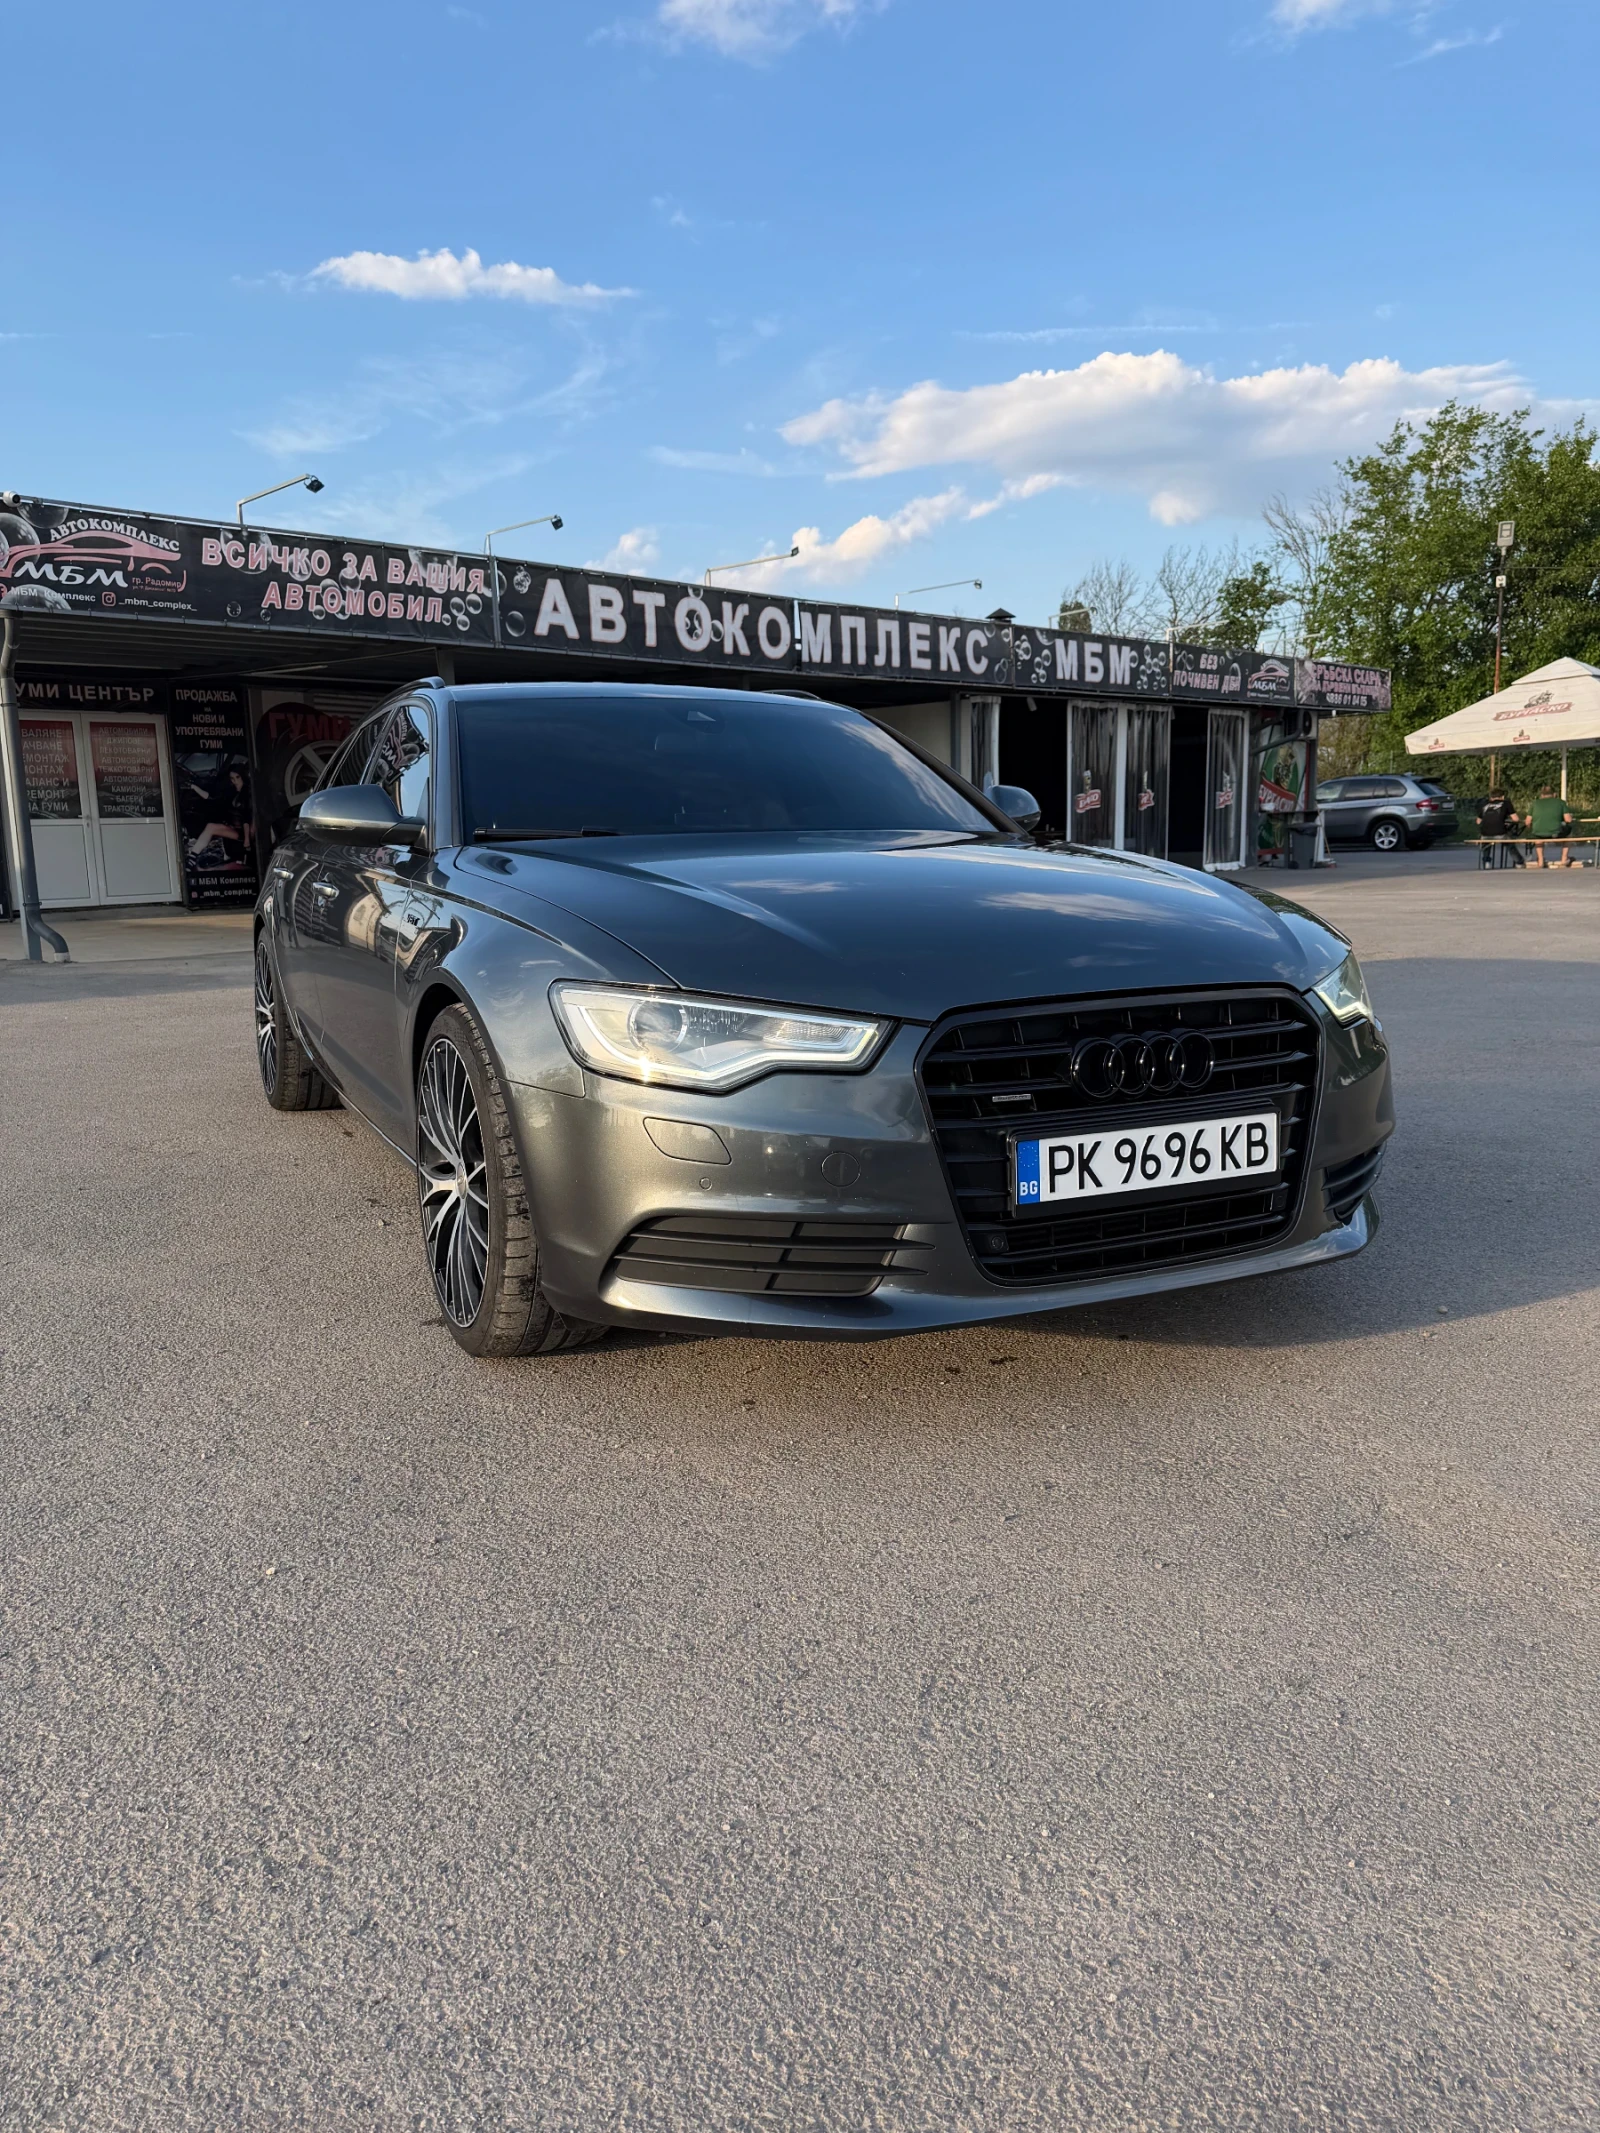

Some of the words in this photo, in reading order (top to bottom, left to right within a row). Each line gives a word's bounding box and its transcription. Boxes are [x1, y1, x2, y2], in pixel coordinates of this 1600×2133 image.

[50, 518, 180, 551] АВТОКОМПЛЕКС
[201, 537, 331, 577] ВСИЧКО
[342, 552, 378, 582] ЗА
[387, 557, 485, 594] ВАШИЯ
[14, 561, 128, 588] МБМ
[145, 576, 182, 588] Радомир
[11, 586, 38, 597] МБМ
[44, 586, 96, 602] Комплекс
[261, 580, 444, 624] АВТОМОБИЛ
[534, 578, 990, 675] АВТОКОМПЛЕКС
[1054, 638, 1131, 685] МБМ
[1199, 653, 1218, 670] БЕЗ
[1173, 670, 1220, 690] ПОЧИВЕН
[1252, 680, 1277, 691] МБМ
[15, 683, 59, 698] УМИ
[69, 685, 154, 701] ЦЕНТЪР
[175, 689, 238, 703] ПРОДАЖБА
[192, 713, 217, 723] НОВИ
[218, 714, 225, 724] И
[21, 728, 62, 738] ВАЛЯНЕ
[175, 726, 244, 736] УПОТРЕБЯВАНИ
[23, 741, 62, 750] АЧВАНЕ
[200, 739, 223, 749] ГУМИ
[25, 777, 60, 787] АЛАНС
[62, 778, 69, 786] И
[28, 802, 39, 811] А
[42, 802, 69, 812] ГУМИ
[198, 877, 218, 885] МБМ
[219, 876, 256, 885] Комплекс
[1048, 1140, 1103, 1193] PK
[1114, 1128, 1211, 1184] 9696
[1220, 1121, 1269, 1171] KB
[1019, 1180, 1038, 1196] BG
